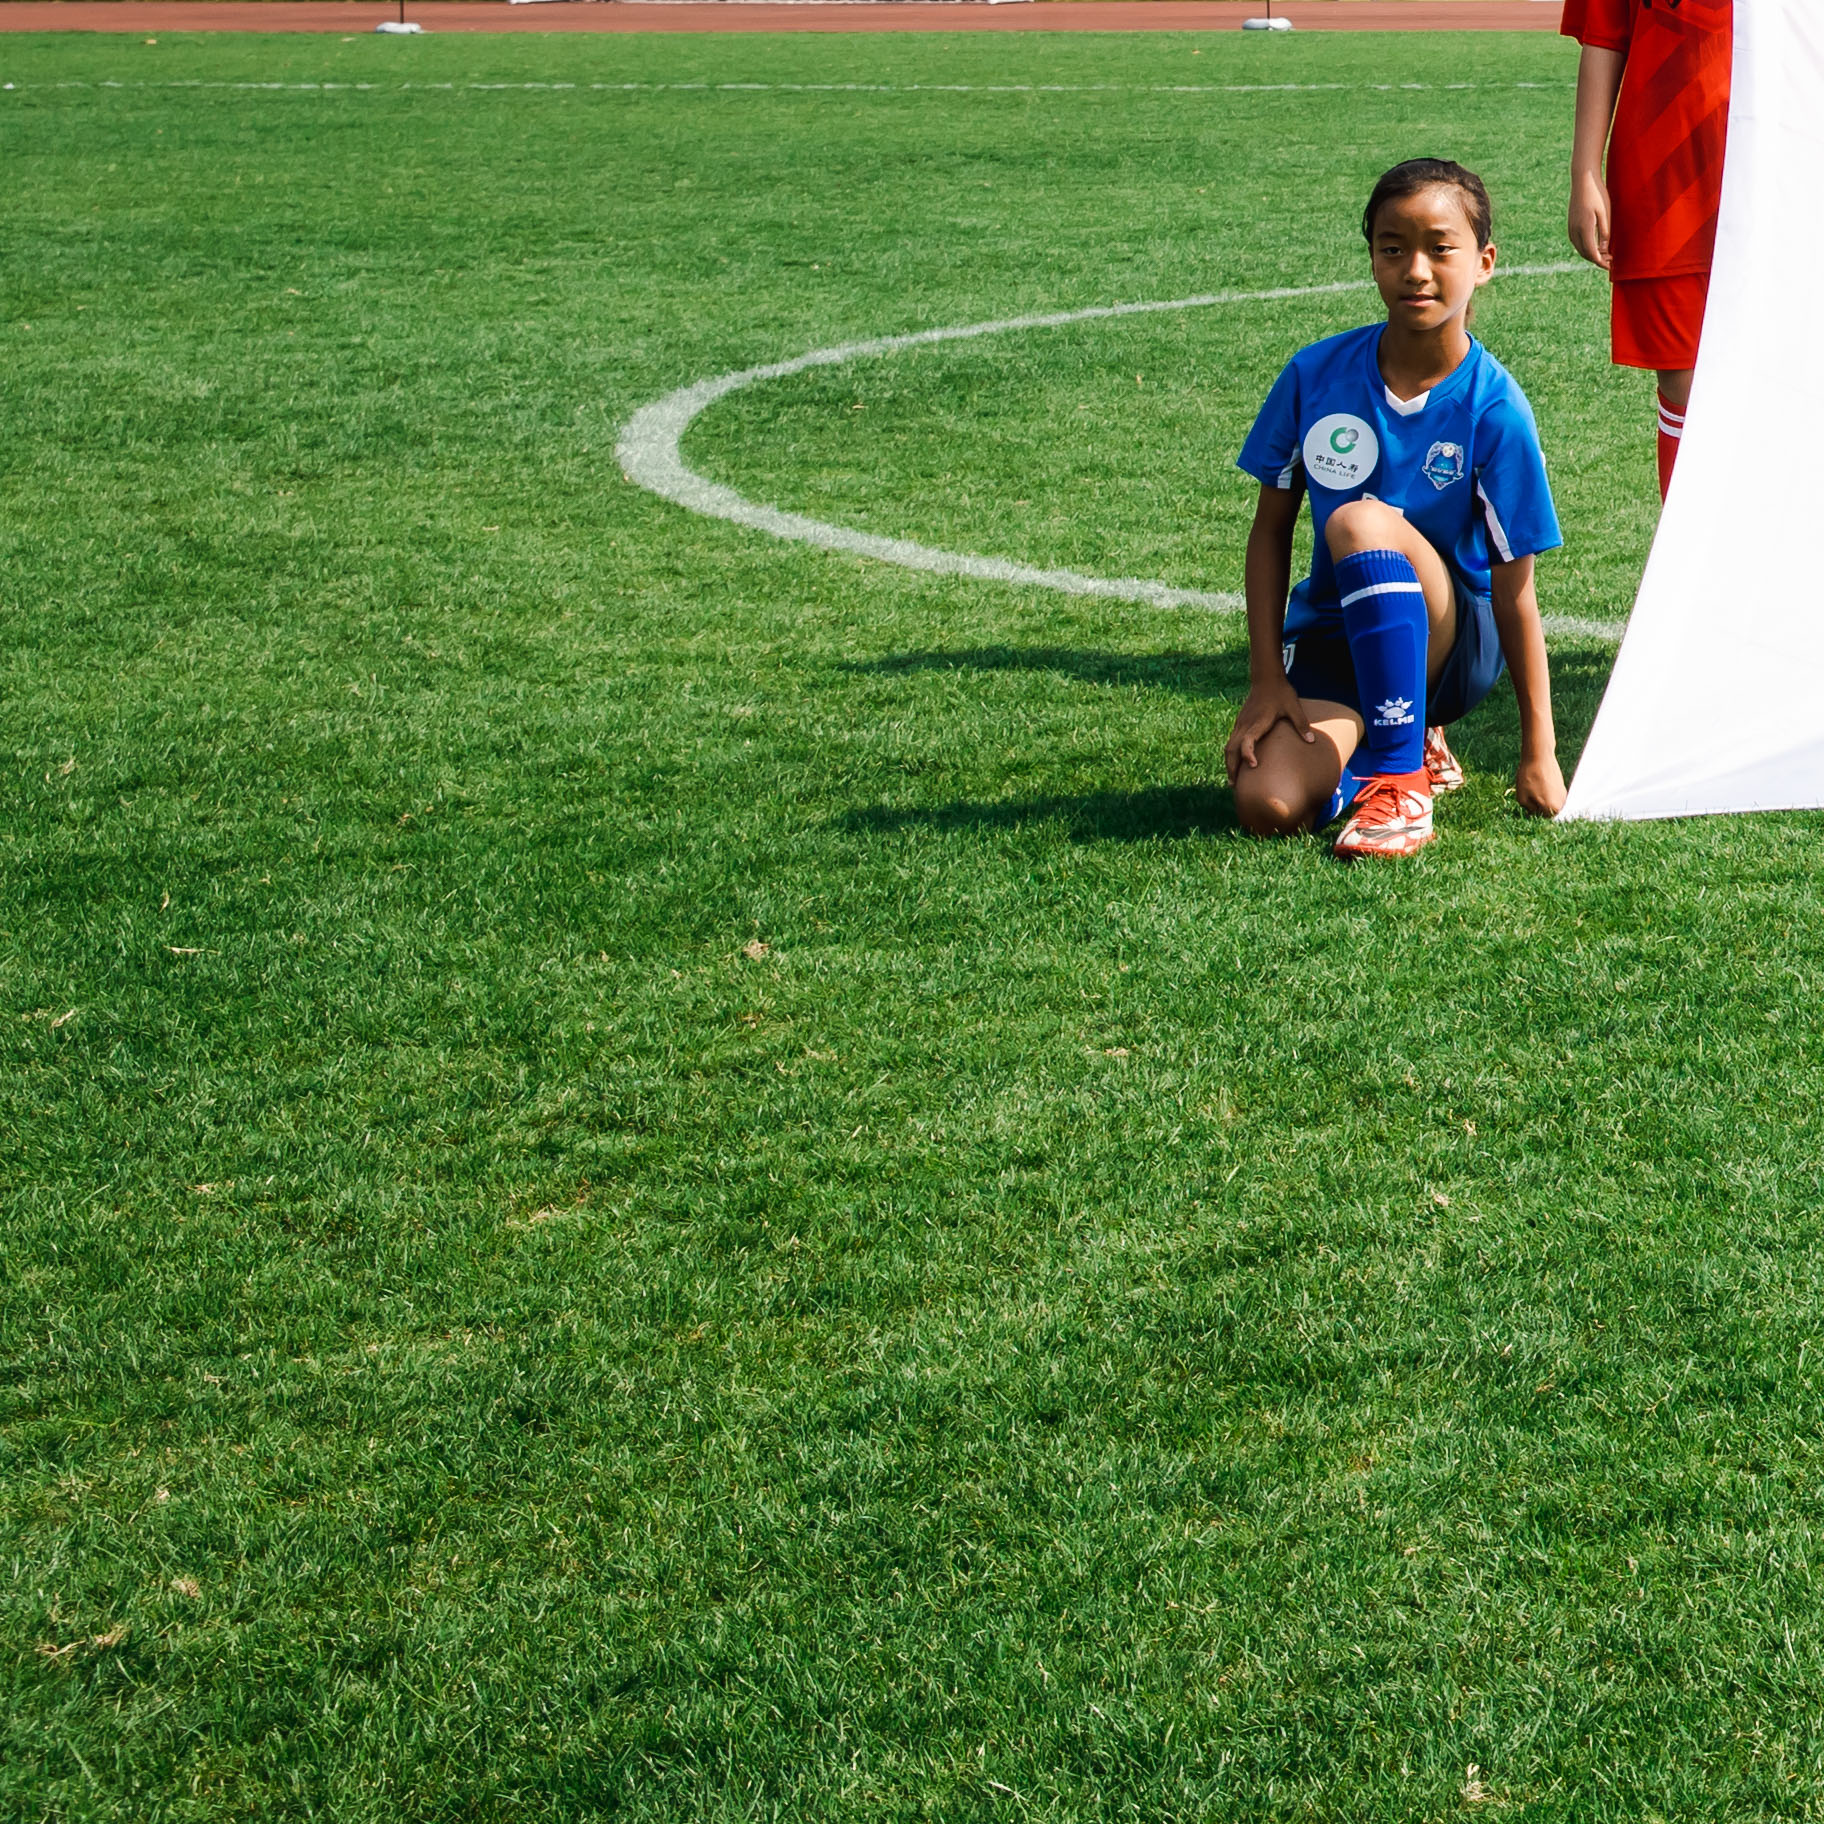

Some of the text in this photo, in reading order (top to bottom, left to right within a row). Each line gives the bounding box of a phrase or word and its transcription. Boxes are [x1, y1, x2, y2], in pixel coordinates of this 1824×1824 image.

[1313, 463, 1357, 479] CHINA LIFE
[1315, 454, 1360, 473] 中国人寿
[1374, 714, 1415, 726] KELME
